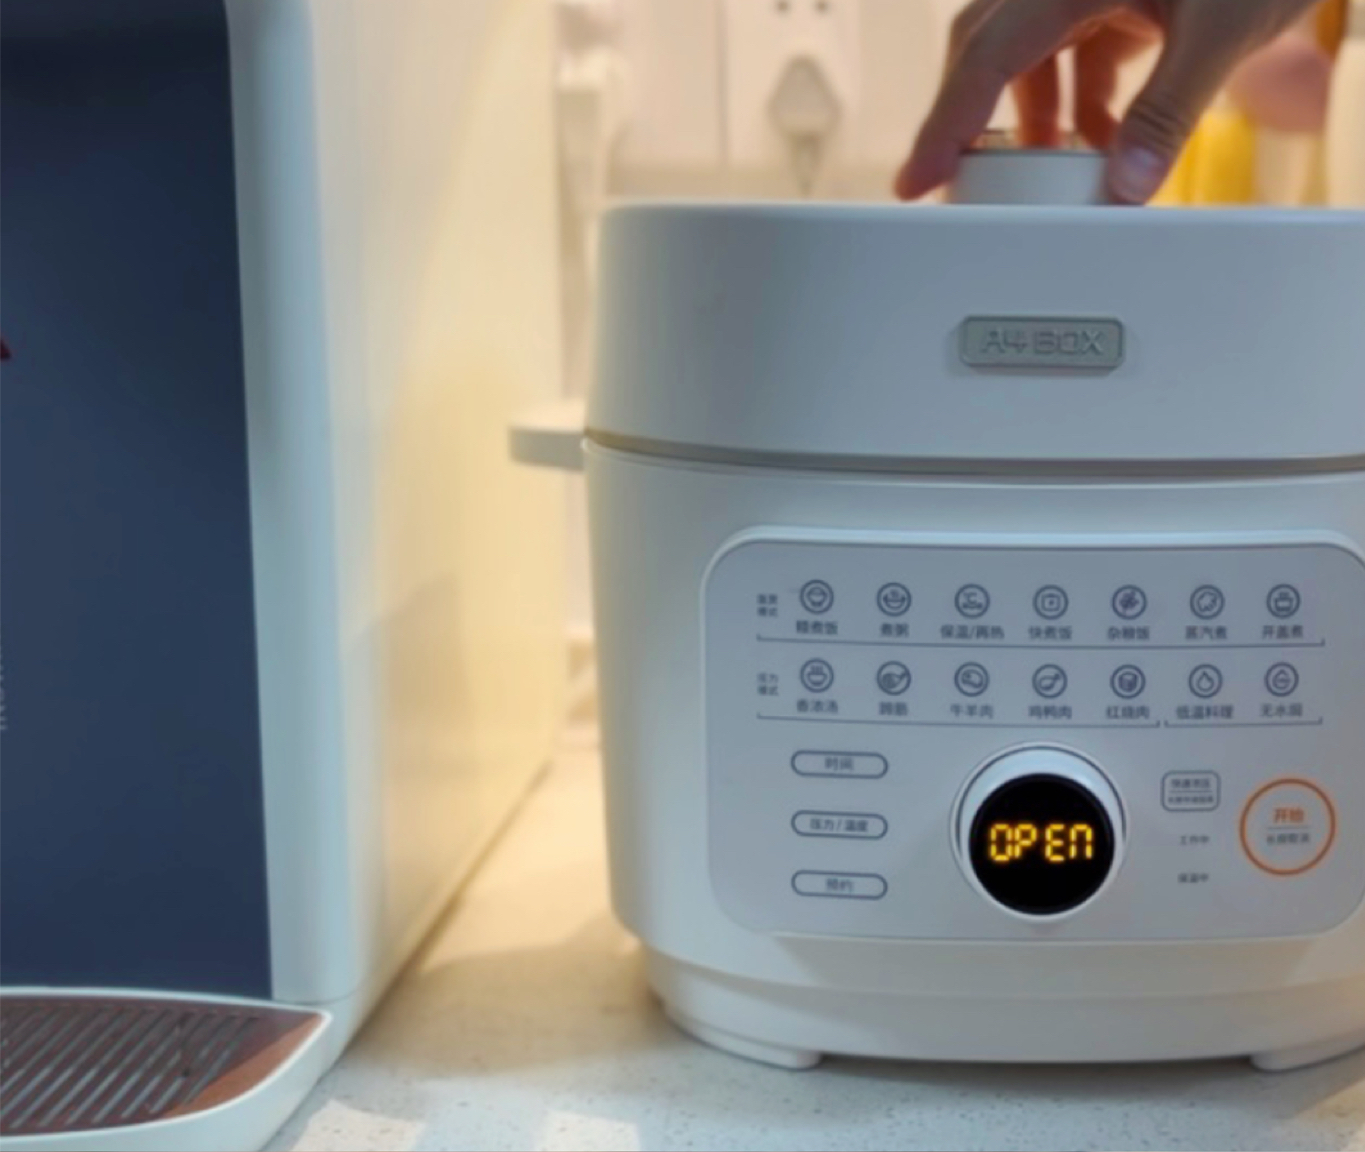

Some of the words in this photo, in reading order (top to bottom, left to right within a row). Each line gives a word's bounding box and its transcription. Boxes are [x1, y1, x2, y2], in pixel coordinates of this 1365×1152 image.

[879, 623, 910, 639] 煮粥
[940, 624, 1005, 640] 保温/再热
[1028, 626, 1072, 640] 快煮饭
[1107, 626, 1150, 641] 杂粮饭
[950, 704, 994, 719] 牛羊肉
[1028, 705, 1072, 720] 鸡鸭肉
[1106, 705, 1150, 720] 红烧肉
[1176, 705, 1235, 720] 低温料理
[824, 757, 854, 771] 时间
[1273, 808, 1305, 823] 开始
[988, 823, 1094, 862] OPEN
[826, 877, 854, 892] 预约
